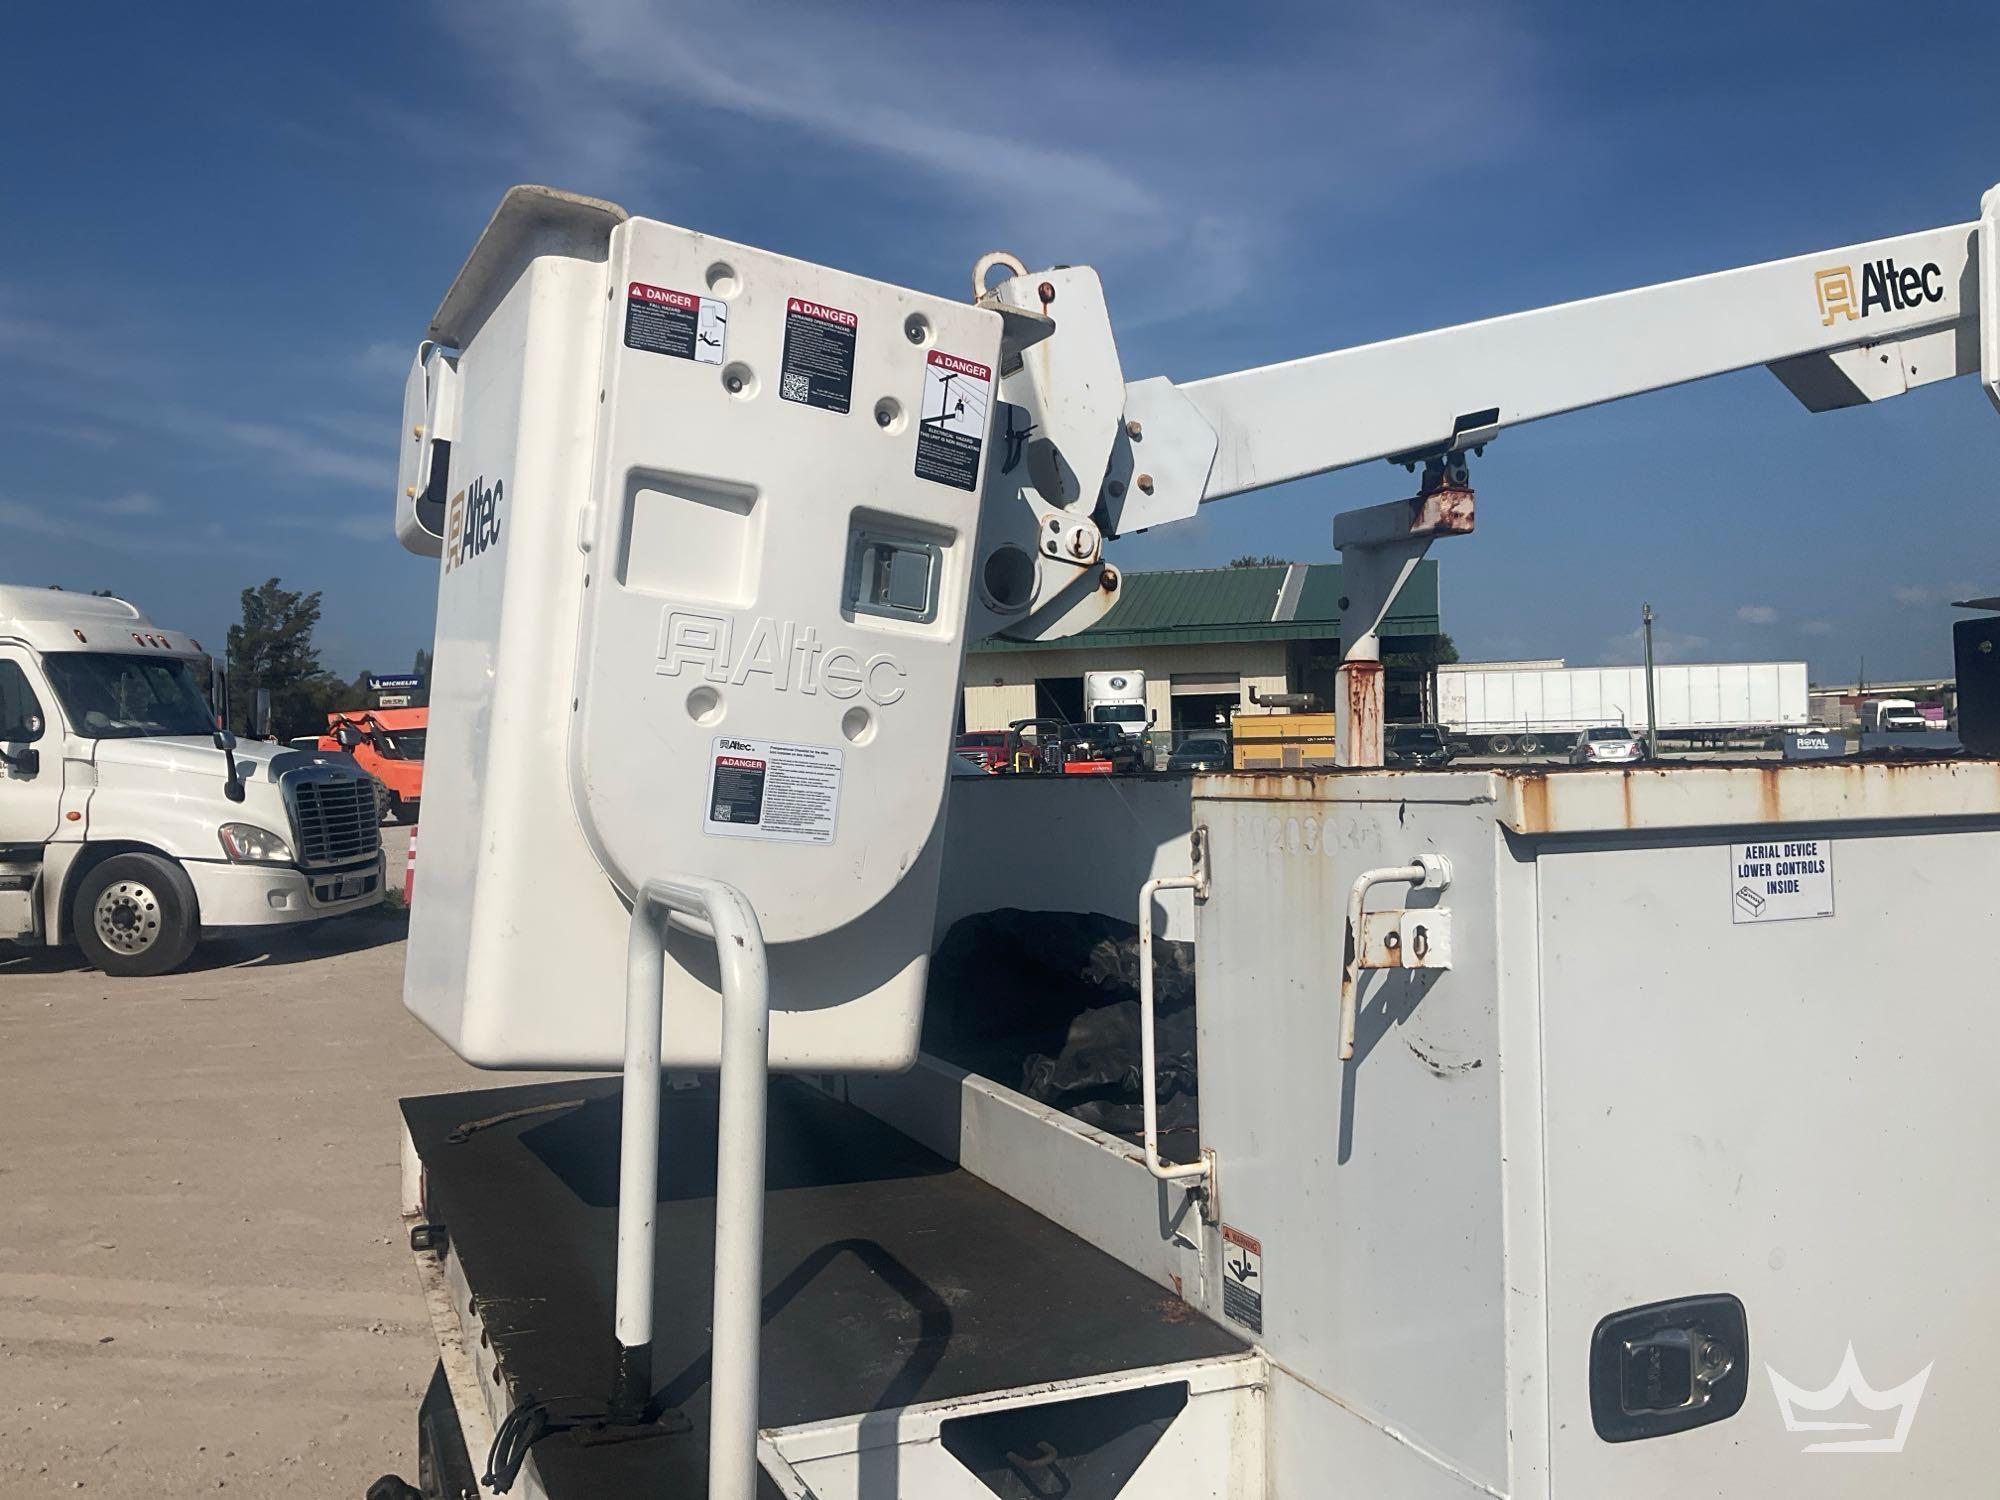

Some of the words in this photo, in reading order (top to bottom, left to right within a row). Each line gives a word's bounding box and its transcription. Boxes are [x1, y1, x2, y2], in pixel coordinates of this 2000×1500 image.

[1861, 258, 1943, 318] Altec
[647, 289, 692, 307] DANGER
[803, 304, 855, 326] DANGER
[945, 358, 987, 378] DANGER
[460, 475, 503, 565] Altec
[730, 616, 907, 706] Altec
[729, 741, 752, 751] Altec
[1797, 738, 1829, 746] ROYAL
[728, 759, 762, 769] DANGER
[1745, 845, 1780, 859] AERIAL
[1784, 843, 1817, 856] DEVICE
[1738, 864, 1771, 878] LOWER
[1776, 860, 1825, 876] CONTROLS
[1767, 880, 1799, 894] INSIDE
[1231, 1232, 1258, 1252] WARNING
